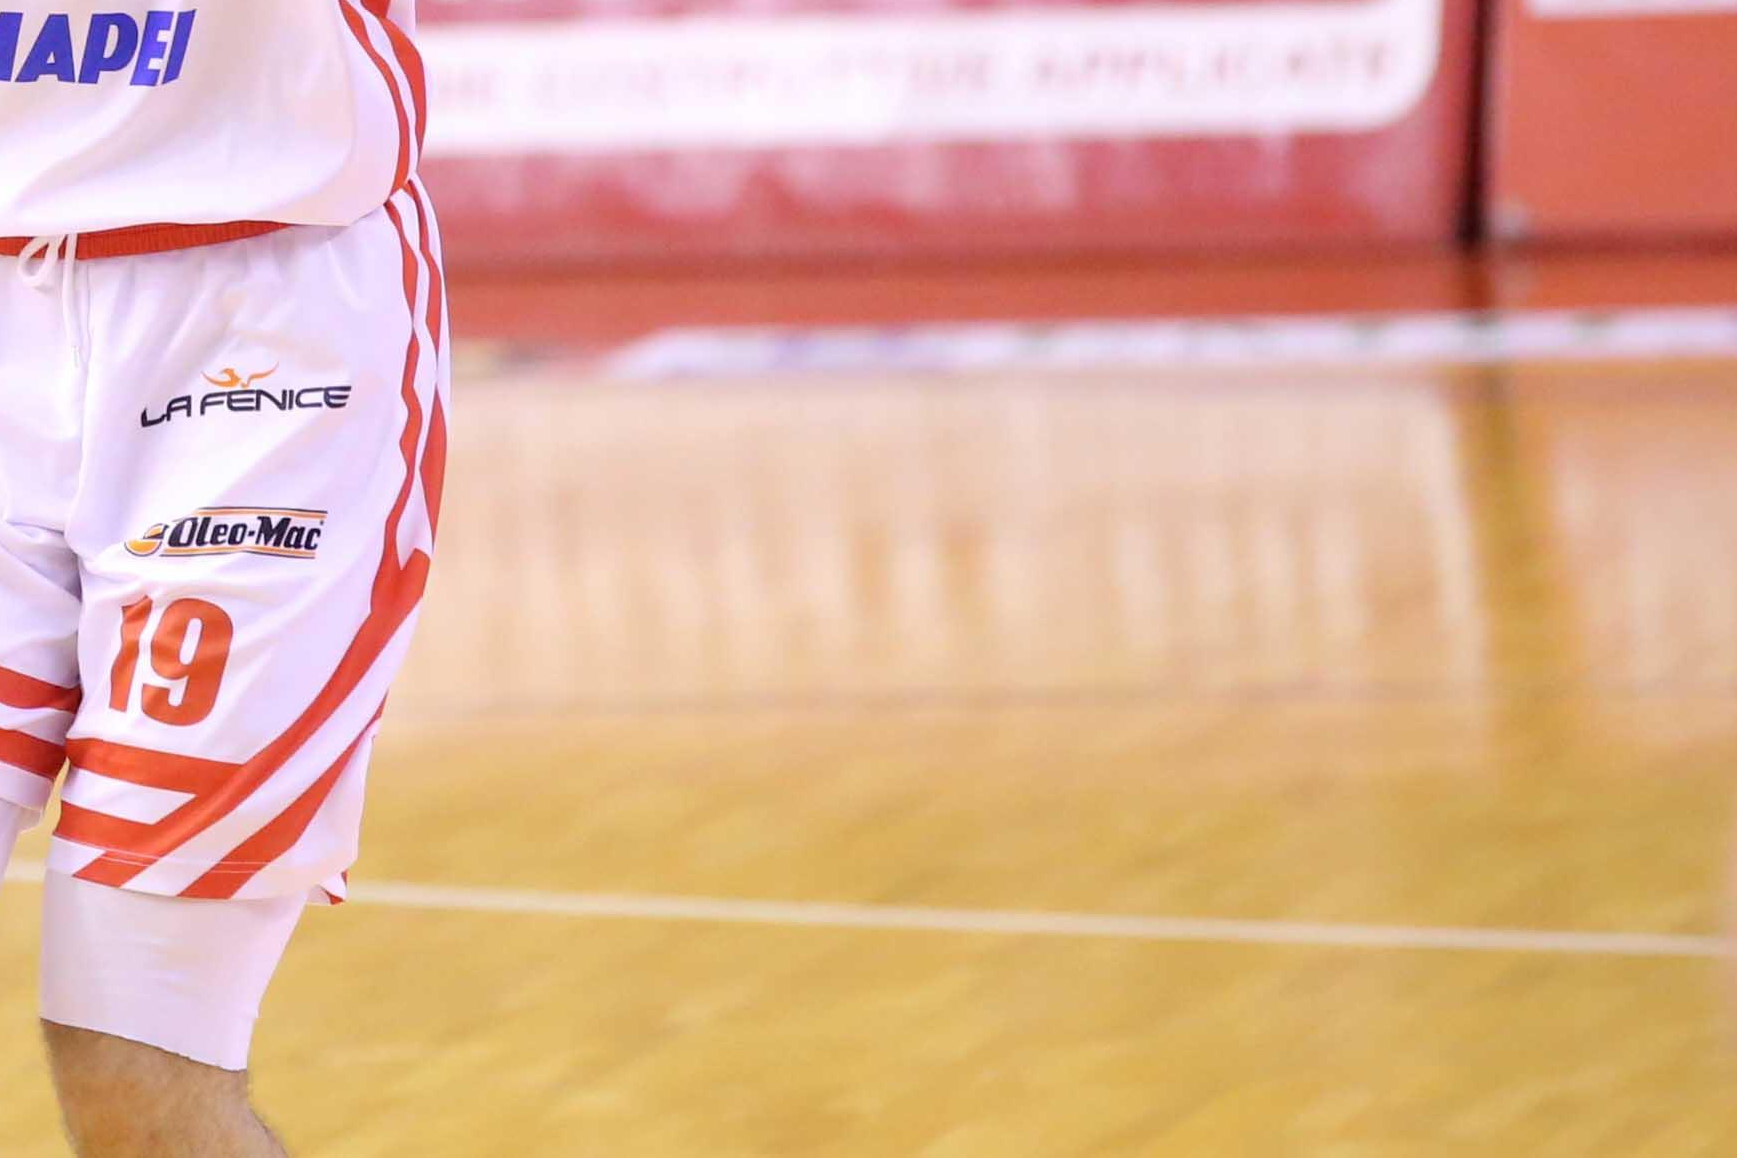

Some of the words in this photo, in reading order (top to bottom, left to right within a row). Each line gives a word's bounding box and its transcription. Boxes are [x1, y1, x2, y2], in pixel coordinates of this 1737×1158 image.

[141, 395, 192, 428] LA
[200, 386, 352, 416] FENICE
[167, 516, 322, 551] Oleo-Mac
[107, 595, 234, 727] 19
